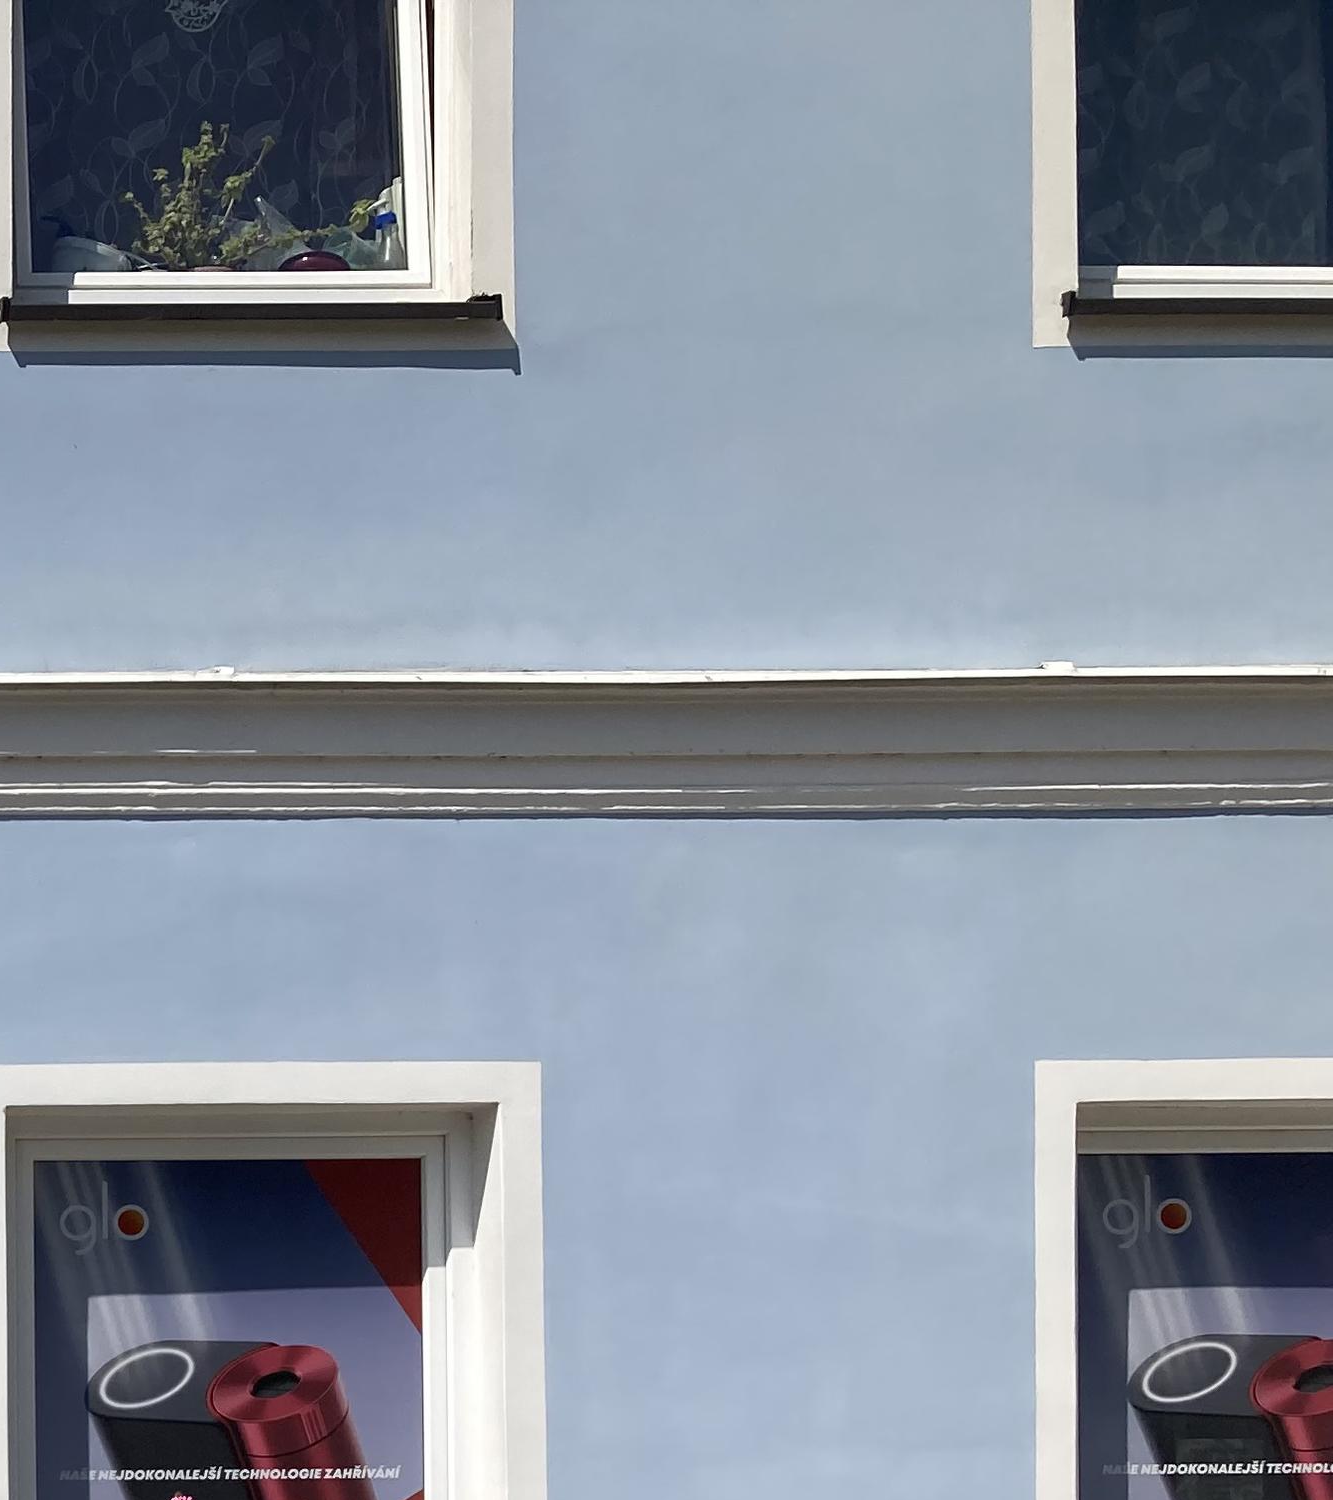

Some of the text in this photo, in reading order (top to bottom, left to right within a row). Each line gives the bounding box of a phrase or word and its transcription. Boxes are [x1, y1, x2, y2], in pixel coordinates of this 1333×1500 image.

[60, 1181, 149, 1255] glo
[1103, 1174, 1192, 1248] glo
[98, 1466, 223, 1480] NEJDOKONALEJŠÍ
[224, 1468, 322, 1480] TECHNOLOGIE
[324, 1465, 401, 1479] ZAHŘÍVÁNÍ
[1141, 1460, 1266, 1475] NEJDOKONALEJŠÍ
[1266, 1462, 1333, 1474] TECHNOL
